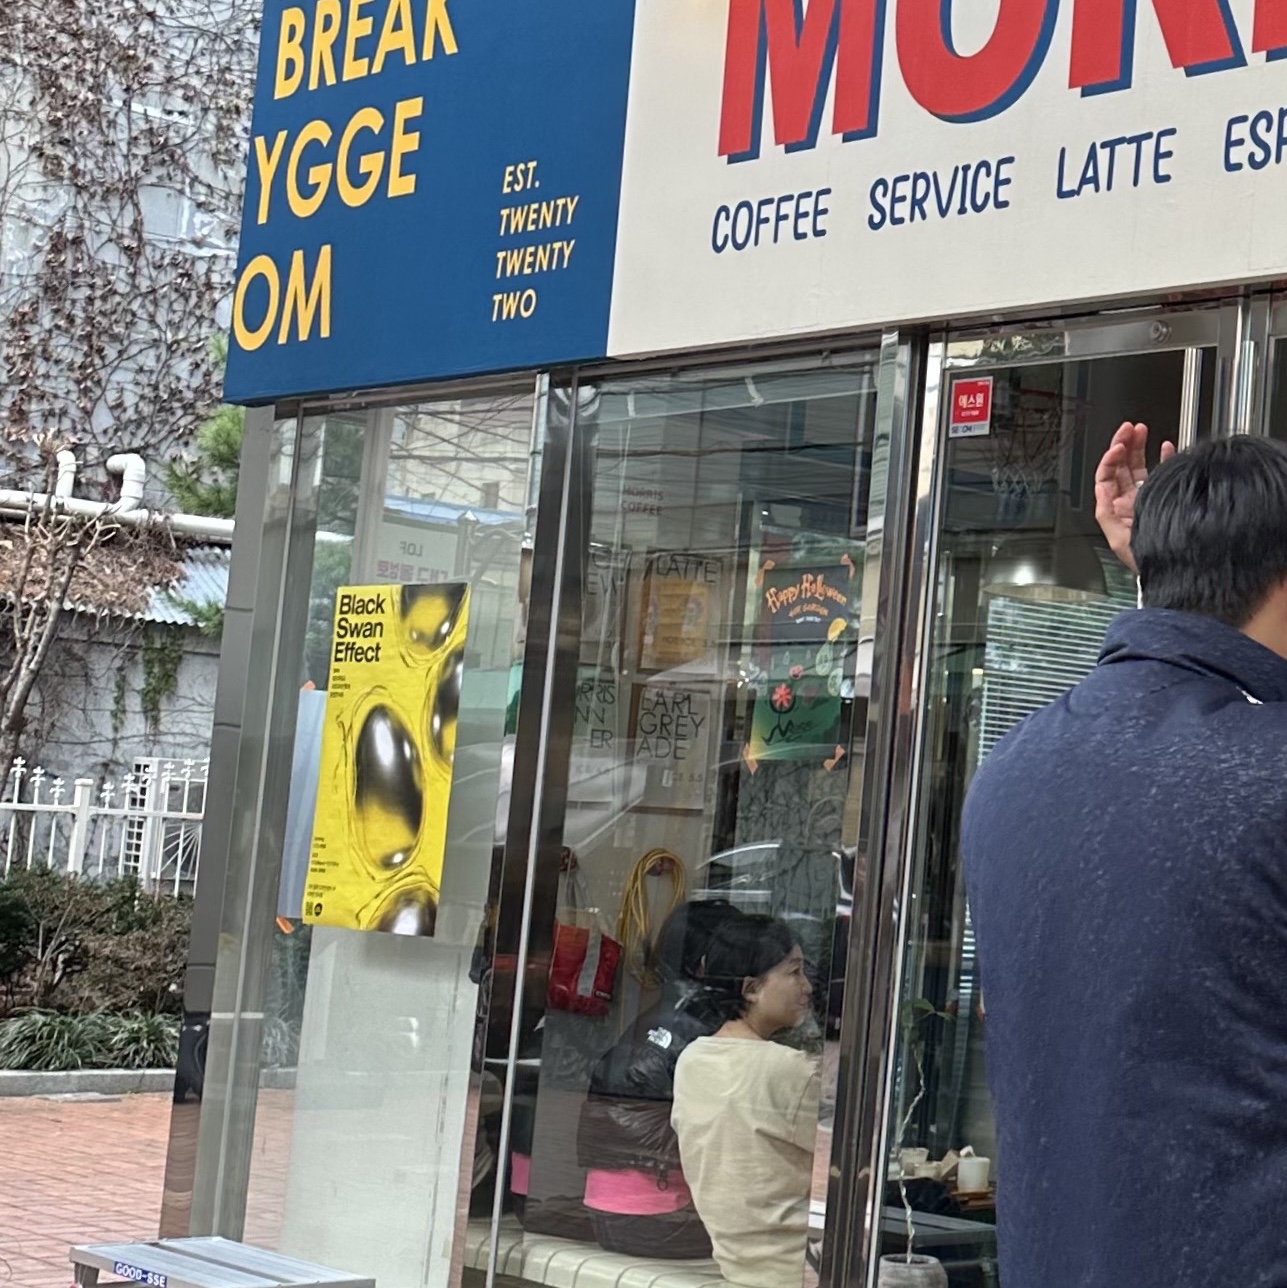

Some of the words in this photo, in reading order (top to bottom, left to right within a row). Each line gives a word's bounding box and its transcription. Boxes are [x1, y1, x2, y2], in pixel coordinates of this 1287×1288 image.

[273, 0, 459, 100] BREAK
[254, 96, 424, 226] YGGE
[502, 160, 541, 194] EST.
[711, 187, 832, 254] COFFEE
[868, 155, 1015, 231] SERVICE
[1056, 127, 1177, 199] LATTE
[499, 195, 580, 237] TWENTY
[495, 239, 576, 280] TWENTY
[233, 243, 332, 352] OM
[491, 287, 537, 322] TWO
[339, 593, 387, 615] Black
[336, 616, 384, 639] Swan
[334, 641, 382, 663] Effect
[641, 690, 700, 716] EARL
[639, 711, 706, 739] GREY
[636, 735, 688, 761] ADE
[114, 1262, 167, 1288] GOOD-SSE
